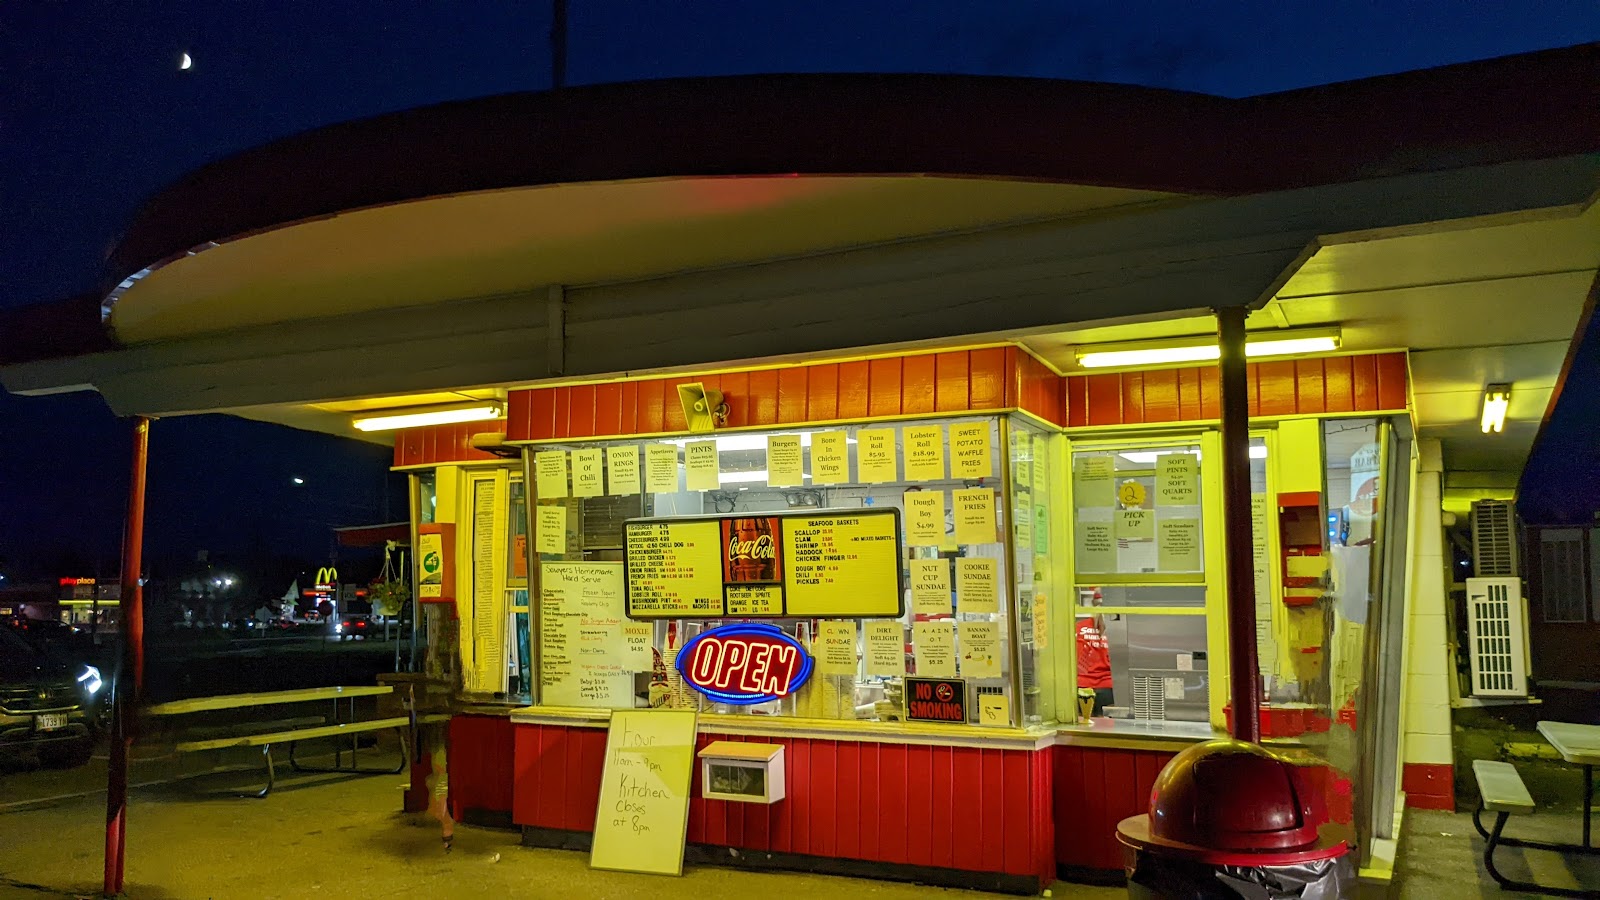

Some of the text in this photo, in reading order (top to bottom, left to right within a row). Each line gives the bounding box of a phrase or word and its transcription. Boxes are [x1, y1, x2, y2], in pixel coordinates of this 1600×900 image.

[958, 429, 981, 437] SWEET
[612, 451, 634, 459] ONION
[650, 450, 674, 458] Appetizers
[958, 448, 984, 456] WAFFLE
[579, 454, 596, 462] Bowl
[614, 460, 634, 468] RINGS
[584, 465, 592, 473] Of
[958, 494, 989, 502] FRENCH
[1124, 486, 1138, 502] 2
[913, 498, 936, 506] Dough
[729, 534, 776, 562] Coca-Cola
[60, 577, 96, 586] playplace
[562, 574, 578, 583] Hard
[692, 638, 797, 695] OPEN
[916, 683, 932, 700] NO
[910, 701, 962, 720] SMOKING
[644, 758, 662, 772] 9pm
[619, 773, 670, 799] Kitchen
[612, 815, 651, 835] at 8pm
